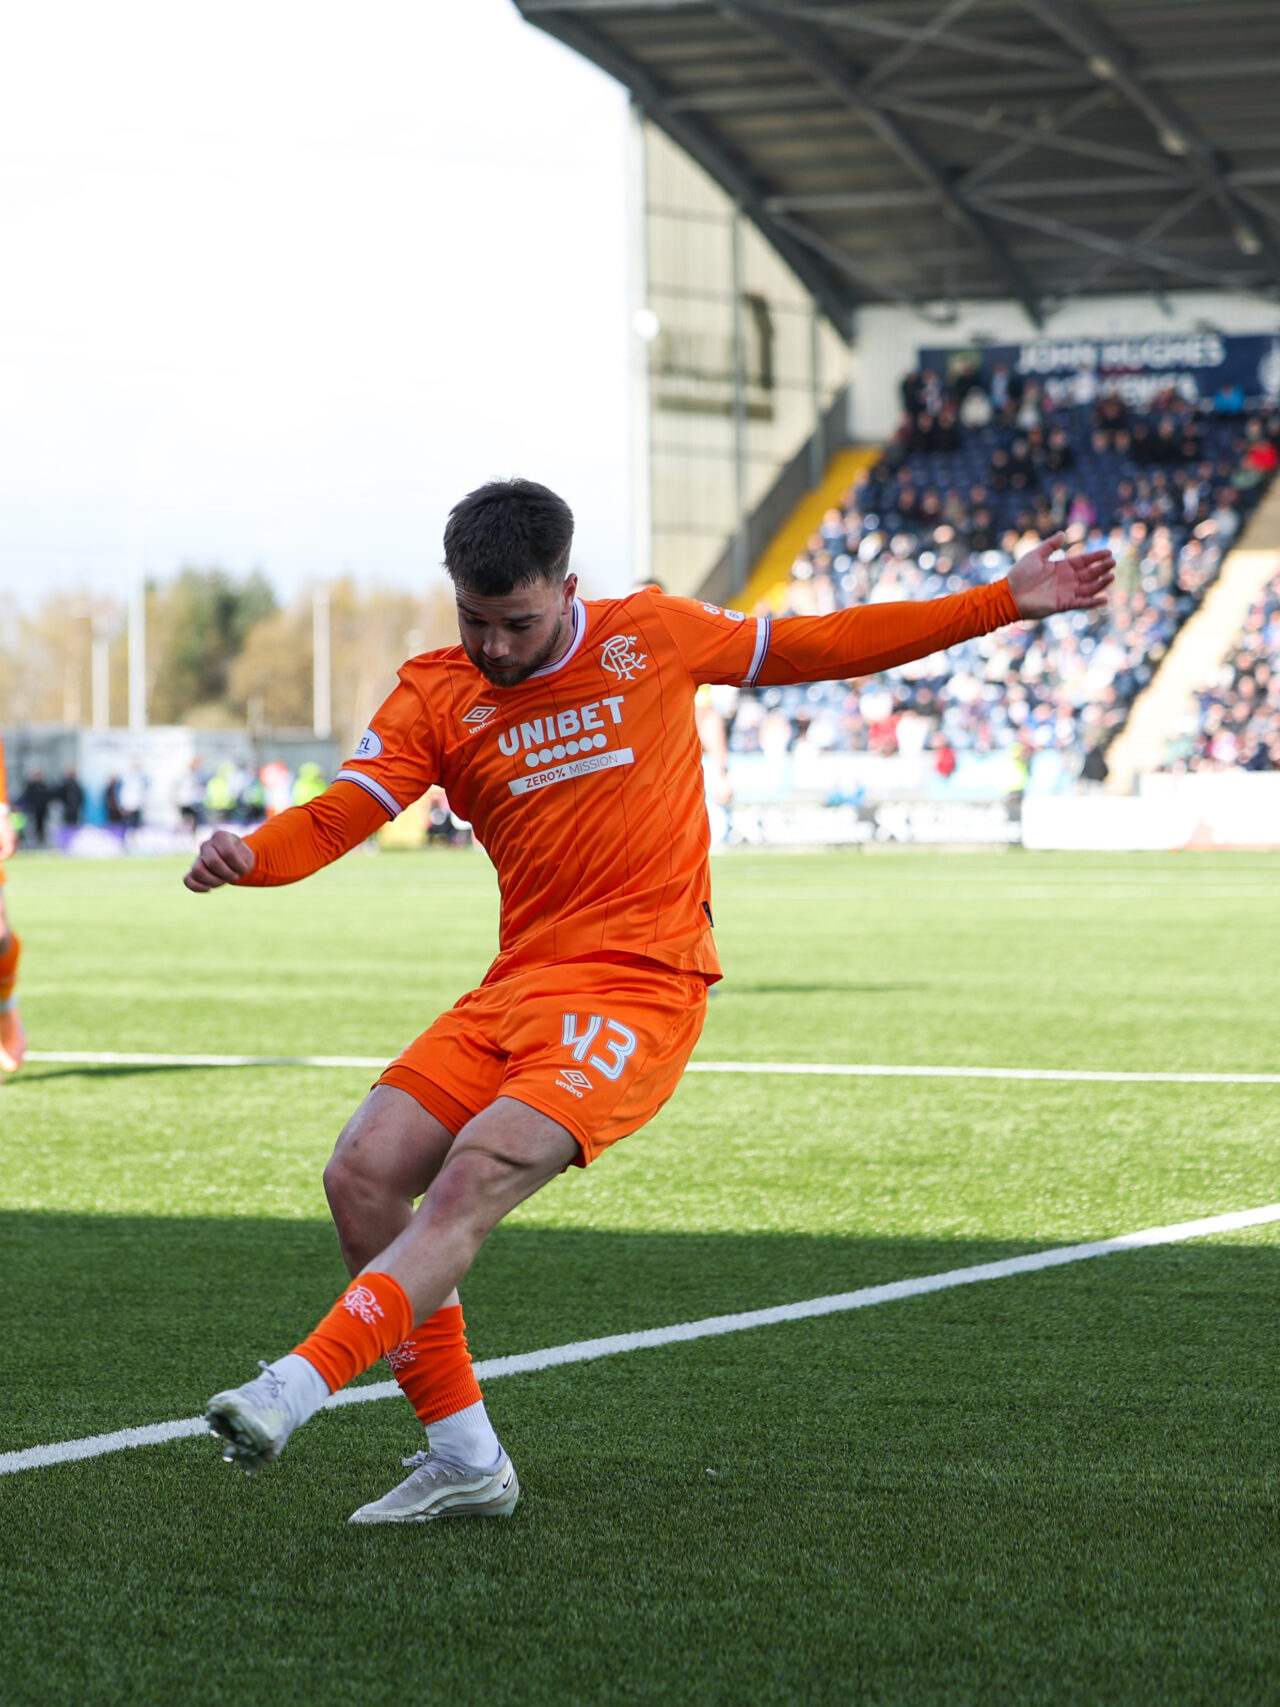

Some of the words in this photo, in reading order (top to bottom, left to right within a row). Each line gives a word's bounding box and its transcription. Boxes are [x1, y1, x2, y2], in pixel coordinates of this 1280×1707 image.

[497, 695, 625, 757] UNIBET
[524, 768, 566, 789] ZERO%
[568, 753, 619, 776] MISSION
[562, 1013, 638, 1081] 43
[555, 1079, 584, 1098] umbro
